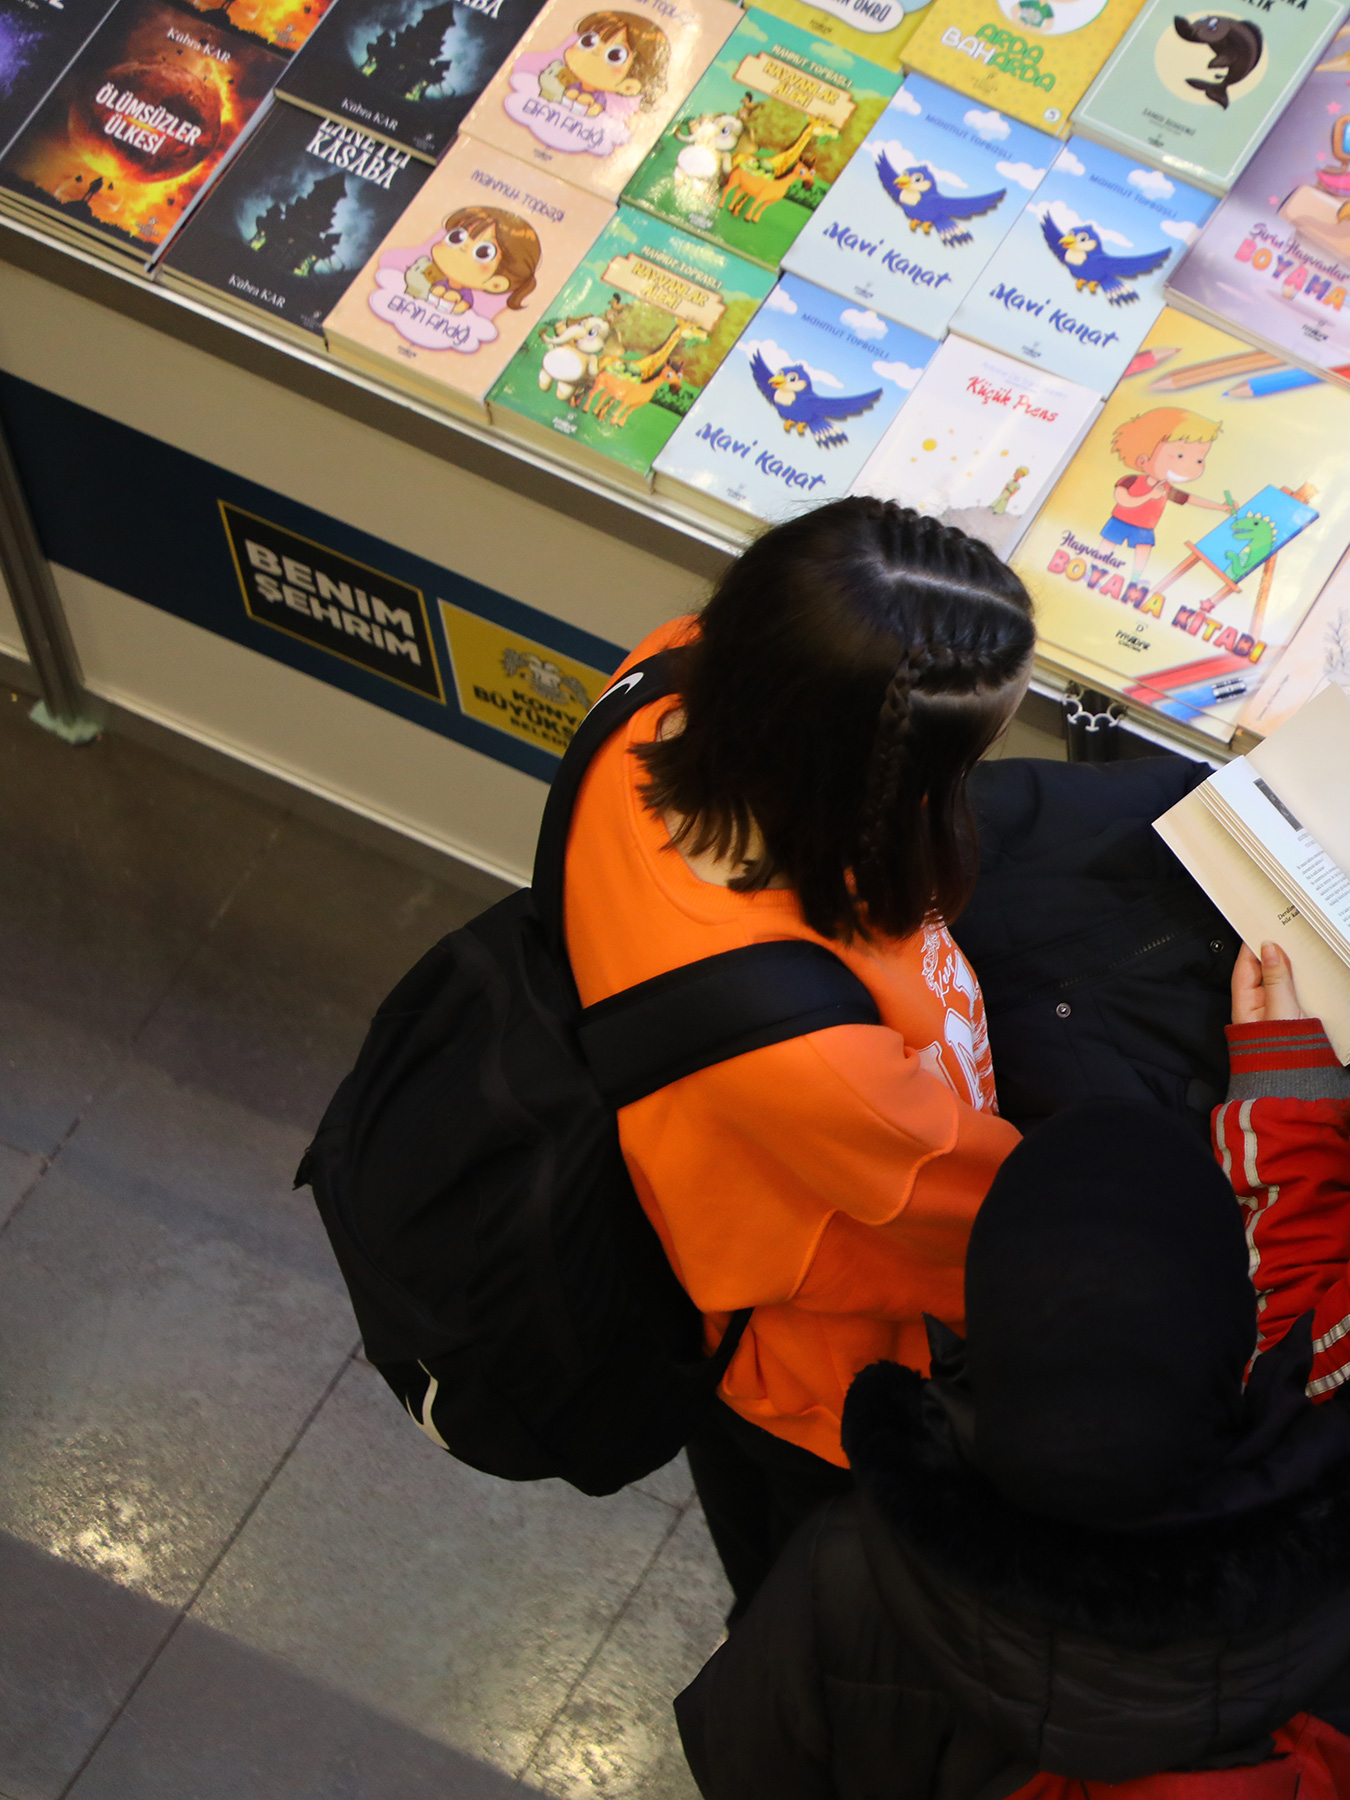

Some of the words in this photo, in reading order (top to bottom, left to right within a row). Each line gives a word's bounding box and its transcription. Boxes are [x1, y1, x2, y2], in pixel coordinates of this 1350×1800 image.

[202, 43, 232, 64] KAR
[976, 23, 1044, 65] ARDA
[763, 61, 839, 105] HAYVANLAR
[95, 82, 202, 146] ÖLÜMSÜZLER
[104, 114, 166, 155] ÜLKESİ
[373, 110, 399, 131] KAR
[306, 131, 399, 190] KASABA
[823, 221, 885, 257] Mavi
[881, 249, 952, 289] Kanat
[1234, 238, 1347, 311] BOYAMA
[260, 288, 286, 309] KAR
[632, 262, 710, 307] HAYVANLAR
[989, 283, 1051, 317] Mavi
[1048, 308, 1119, 348] Kanat
[966, 375, 1012, 406] Küçük
[1013, 394, 1059, 423] Prens
[695, 422, 757, 458] Mavi
[755, 450, 826, 491] Kanat
[1060, 529, 1127, 570] Hayvanlar
[1047, 549, 1166, 619] BOYAMA
[1171, 599, 1267, 663] KİTABI
[512, 689, 577, 725] KONY
